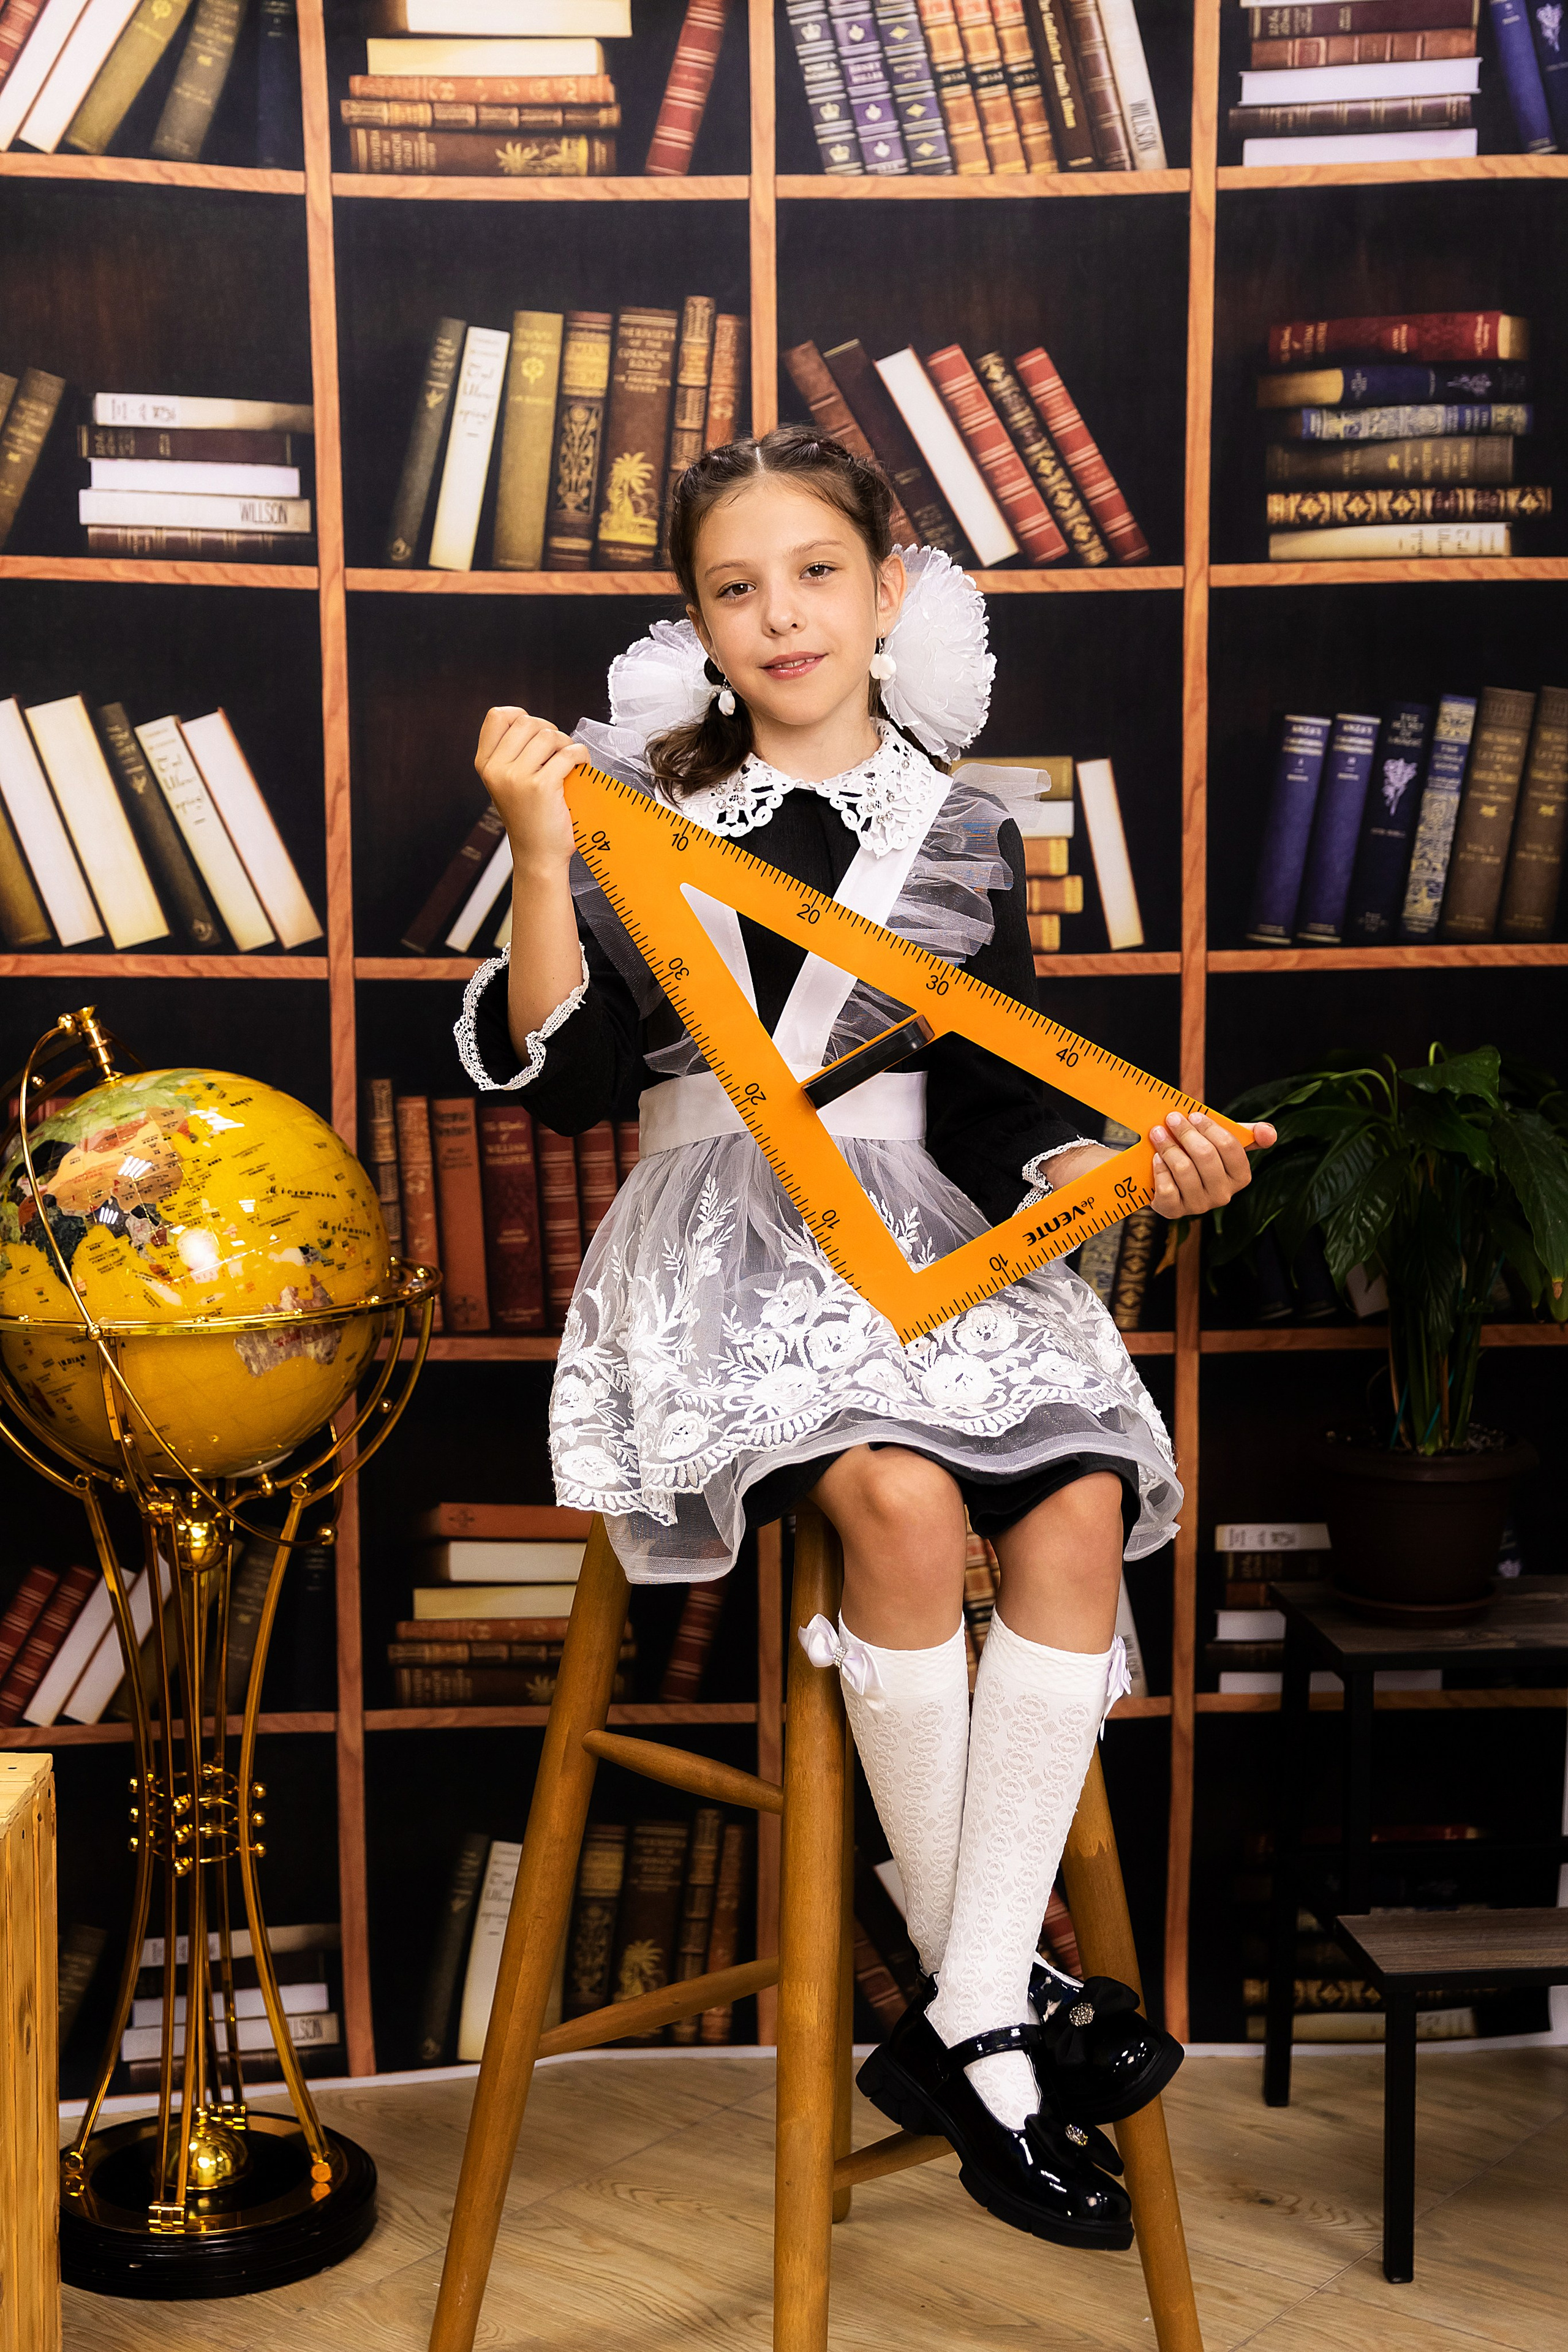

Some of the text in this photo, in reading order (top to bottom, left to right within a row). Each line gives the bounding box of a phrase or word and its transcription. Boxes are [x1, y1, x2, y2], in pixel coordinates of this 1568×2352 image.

[1130, 98, 1158, 152] WILLSON
[239, 502, 288, 524] WILLSON
[592, 831, 610, 851] 40
[672, 833, 688, 851] 10
[796, 903, 820, 924] 20
[669, 957, 689, 980] 30
[926, 975, 949, 995] 30
[1056, 1048, 1079, 1067] 40
[745, 1083, 766, 1105] 20
[1115, 1177, 1137, 1198] 20
[822, 1210, 840, 1229] 10
[990, 1253, 1008, 1271] 10
